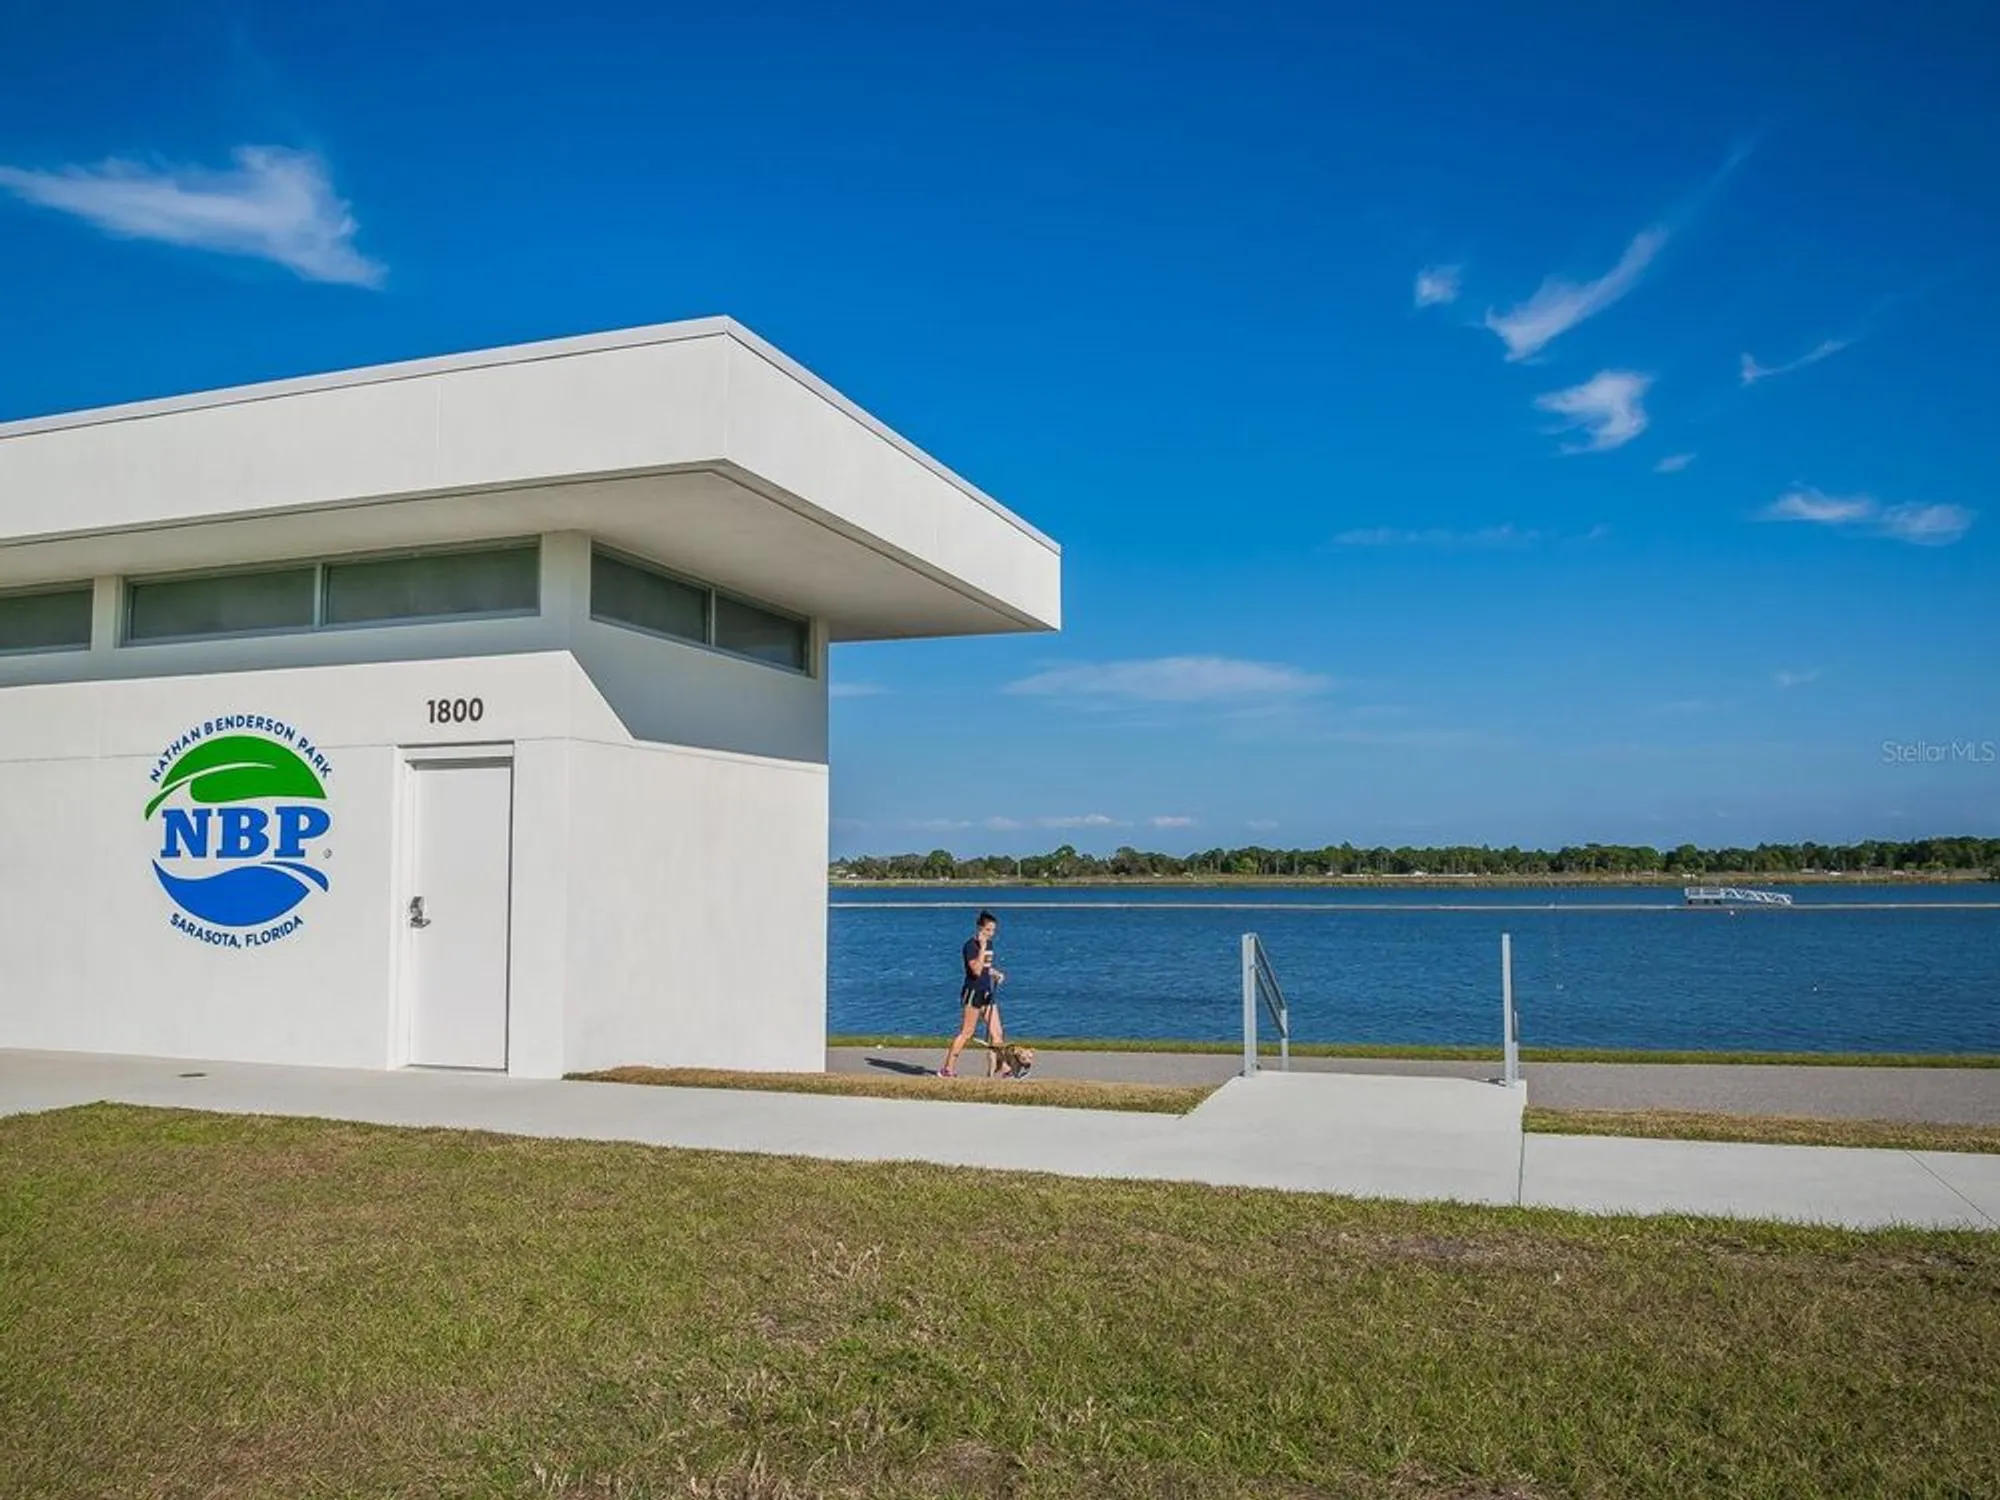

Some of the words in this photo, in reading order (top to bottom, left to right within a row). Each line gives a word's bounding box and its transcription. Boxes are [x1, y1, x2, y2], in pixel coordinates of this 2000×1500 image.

[427, 698, 483, 723] 1800
[150, 728, 201, 783] NATHAN
[203, 714, 296, 741] BENDERSON
[297, 737, 333, 779] PARK
[160, 806, 331, 859] NBP
[170, 913, 242, 949] SARASOTA,
[245, 915, 304, 946] FLORIDA
